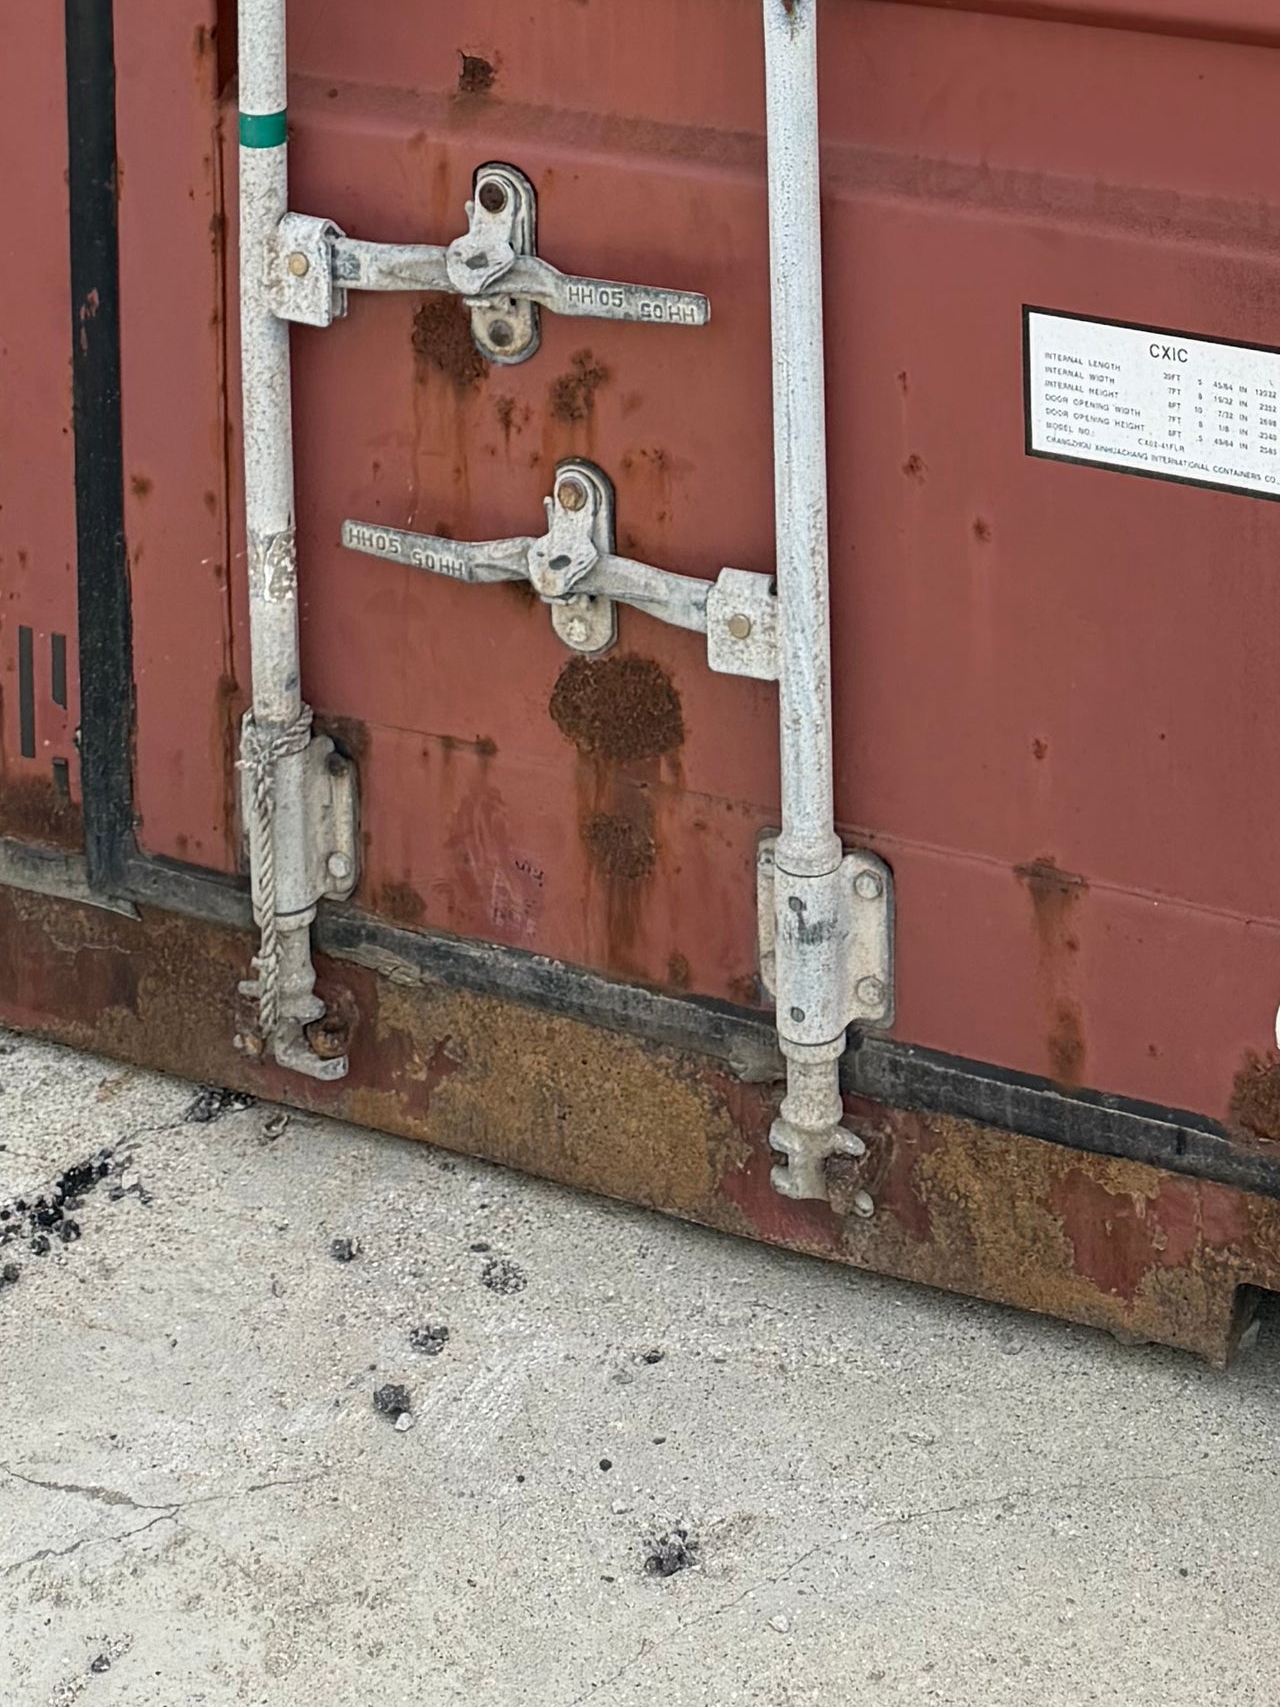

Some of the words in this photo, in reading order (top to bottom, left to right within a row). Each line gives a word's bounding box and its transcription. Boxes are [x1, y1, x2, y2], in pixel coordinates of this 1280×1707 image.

[1044, 351, 1083, 365] INTERNAL
[1087, 358, 1120, 372] LENGTH
[1149, 343, 1188, 363] CXIC
[1044, 365, 1084, 379] INTERNAL
[1088, 373, 1115, 385] WIDTH
